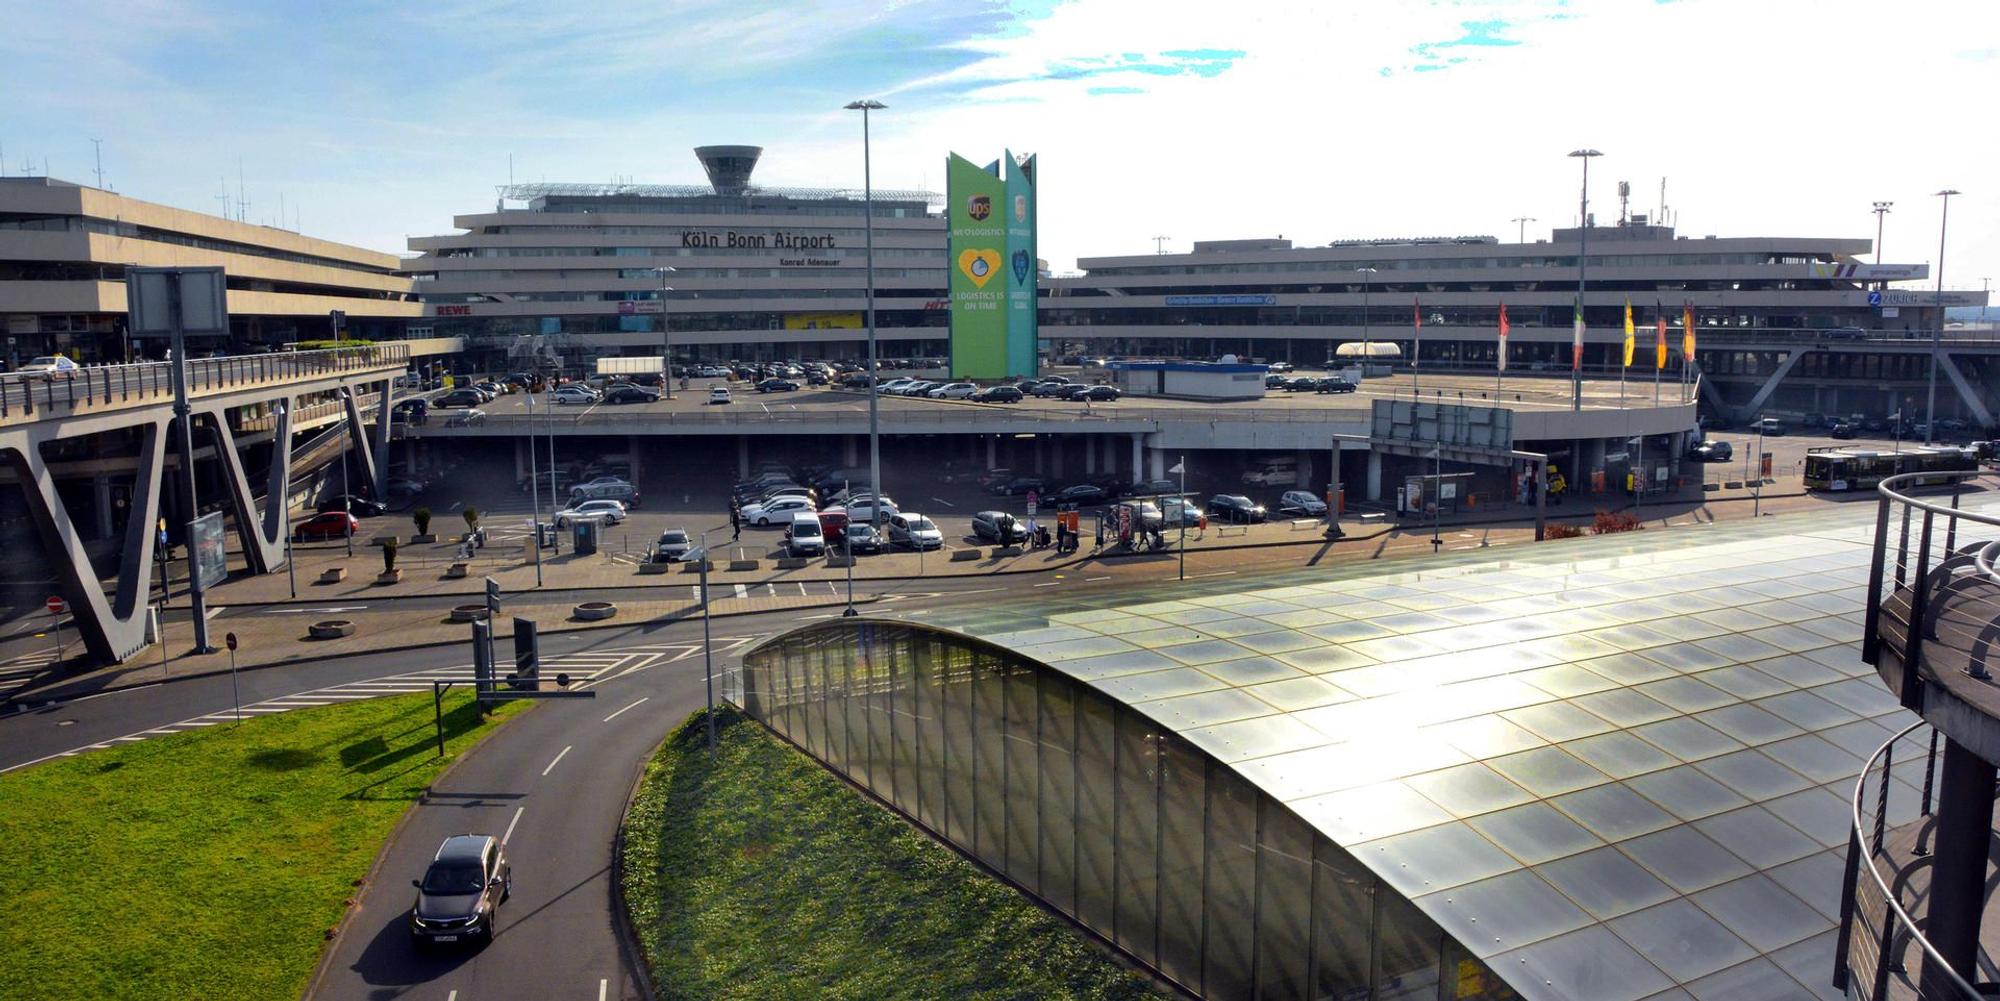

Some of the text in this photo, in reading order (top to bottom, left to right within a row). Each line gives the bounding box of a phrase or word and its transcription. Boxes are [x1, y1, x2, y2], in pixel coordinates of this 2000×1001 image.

[969, 203, 990, 218] ups
[682, 231, 835, 252] Köln Bonn Airport
[780, 258, 841, 266] Konrad Adenauer
[957, 291, 996, 300] LOGISTICS
[997, 291, 1004, 300] IS
[436, 305, 472, 316] REWE
[964, 302, 997, 310] ON TIME
